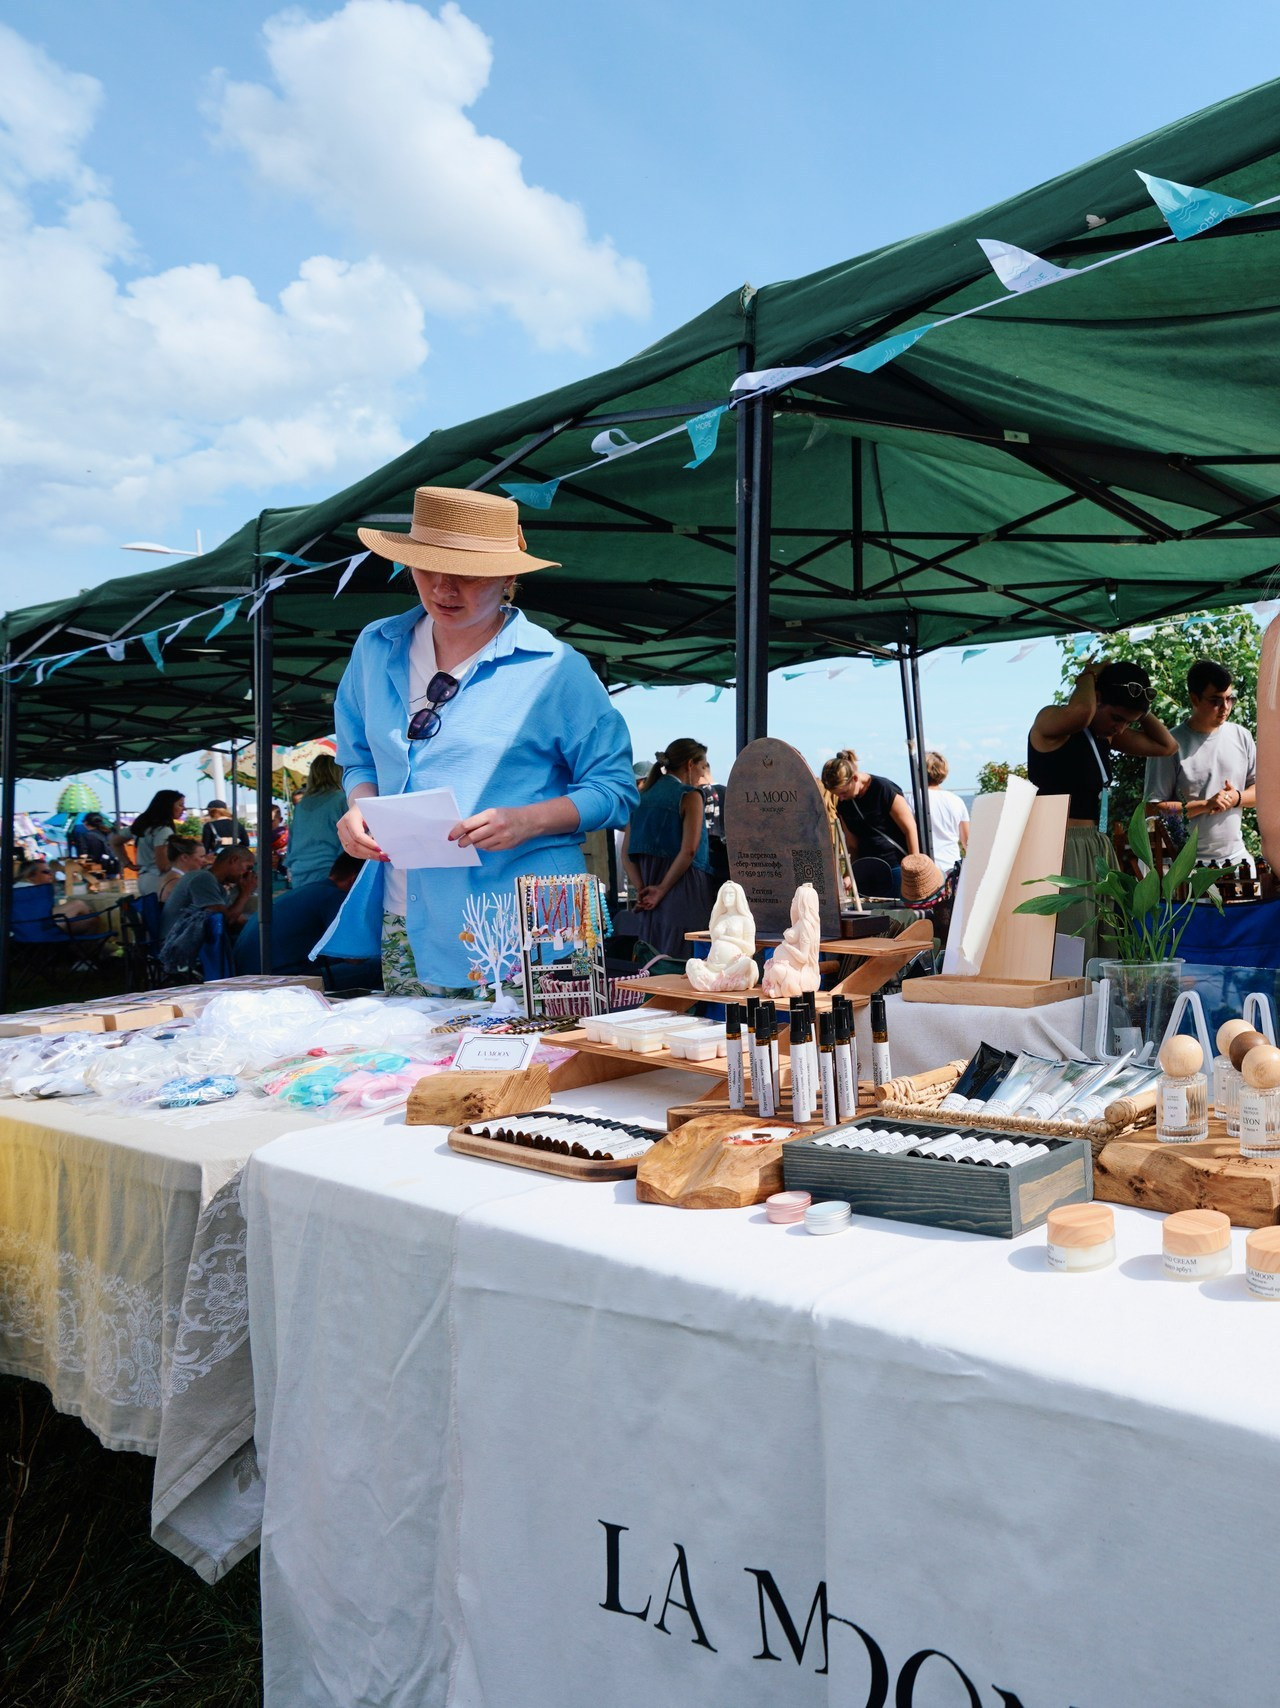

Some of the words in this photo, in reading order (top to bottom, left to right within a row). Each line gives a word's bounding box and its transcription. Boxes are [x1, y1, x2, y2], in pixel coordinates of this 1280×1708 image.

[745, 791, 760, 803] LA
[762, 790, 798, 803] MOON
[1242, 1116, 1260, 1126] LYON
[1173, 1257, 1197, 1265] CREAM
[598, 1519, 718, 1653] LA
